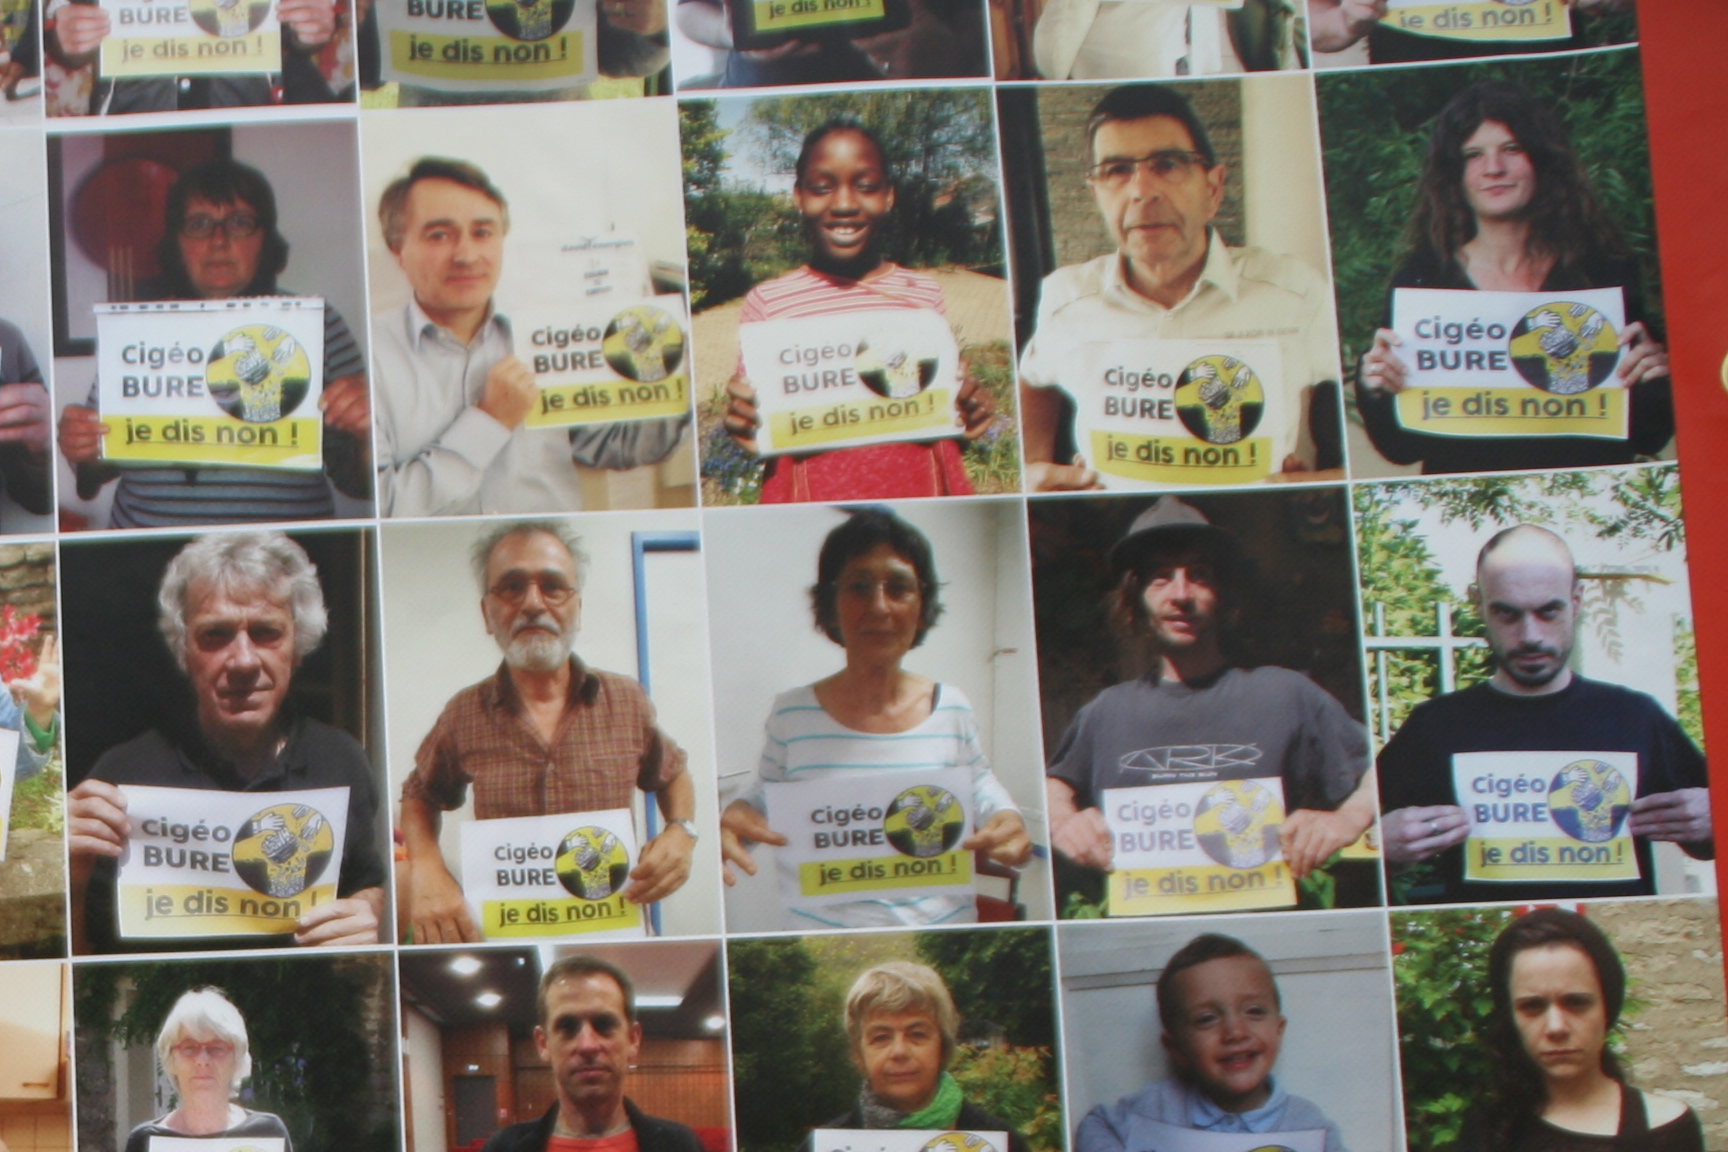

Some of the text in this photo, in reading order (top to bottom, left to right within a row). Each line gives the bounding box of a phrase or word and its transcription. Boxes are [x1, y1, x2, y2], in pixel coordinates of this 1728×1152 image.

[1415, 317, 1506, 345] Cigéo
[122, 342, 204, 370] Cigéo
[1417, 350, 1507, 370] BURE
[122, 376, 203, 398] BURE
[1422, 390, 1451, 420] je
[1461, 388, 1511, 416] dis
[1520, 394, 1587, 416] non
[126, 419, 151, 445] je
[160, 419, 204, 444] dis
[217, 427, 278, 446] non
[1472, 774, 1546, 798] Cigéo
[1473, 803, 1548, 823] BURE
[494, 843, 553, 864] Cigéo
[1480, 842, 1501, 868] je
[1510, 841, 1549, 863] dis
[1558, 845, 1610, 863] non
[497, 868, 556, 886] BURE
[499, 902, 519, 926] je
[527, 900, 559, 921] dis
[567, 902, 610, 920] non
